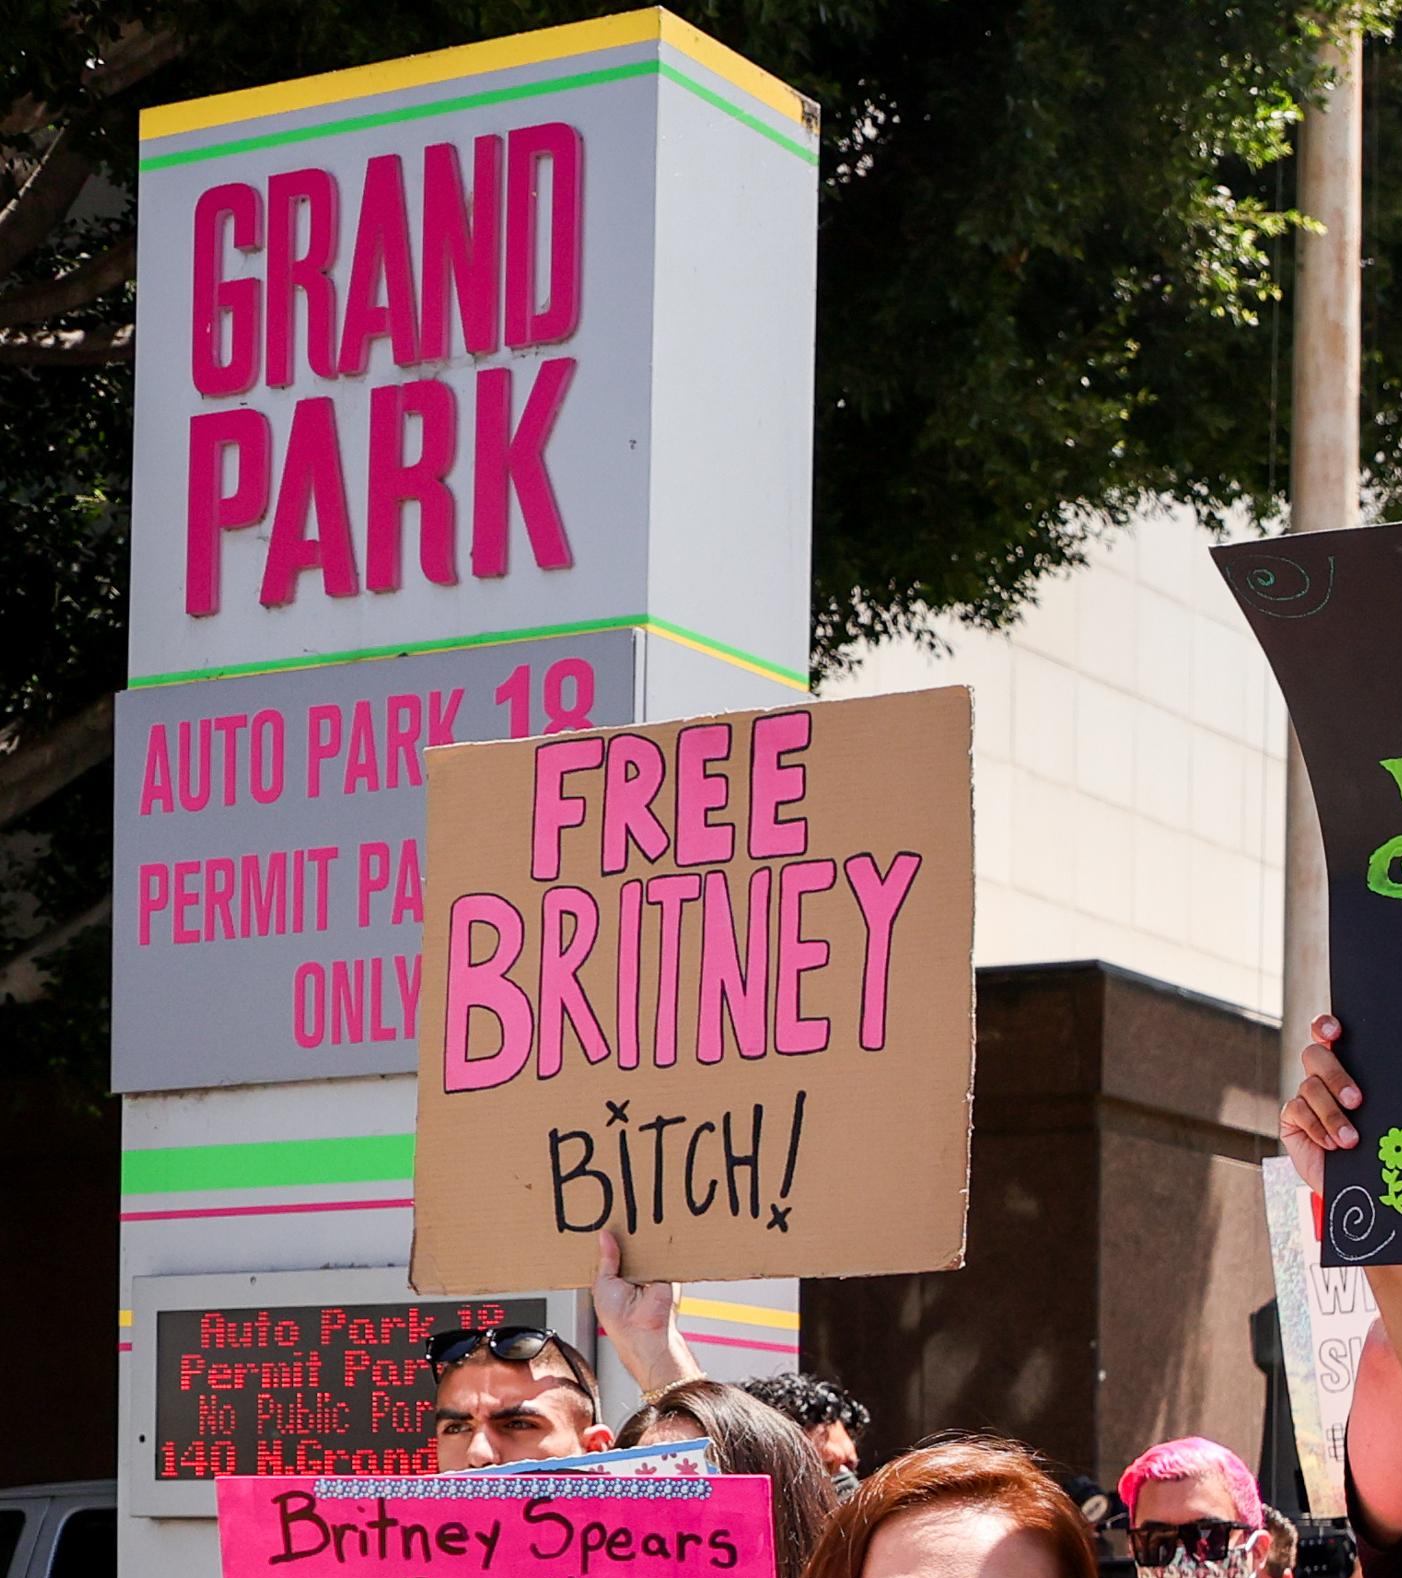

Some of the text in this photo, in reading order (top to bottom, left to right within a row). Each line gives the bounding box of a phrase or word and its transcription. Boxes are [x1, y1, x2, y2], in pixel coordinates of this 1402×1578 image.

[191, 121, 584, 399] GRAND
[185, 357, 576, 618] PARK
[138, 658, 597, 816] AUTO PARK 18
[531, 710, 812, 882] FREE
[138, 847, 338, 946] PERMIT
[293, 954, 421, 1048] ONLY
[443, 851, 923, 1094] BRITNEY
[180, 1349, 441, 1390] Permit Par
[200, 1310, 299, 1348] Auto
[320, 1307, 436, 1346] Park
[161, 1439, 237, 1477] 140
[198, 1394, 236, 1436] No
[257, 1392, 350, 1434] Public
[268, 1489, 739, 1575] Britney Spears
